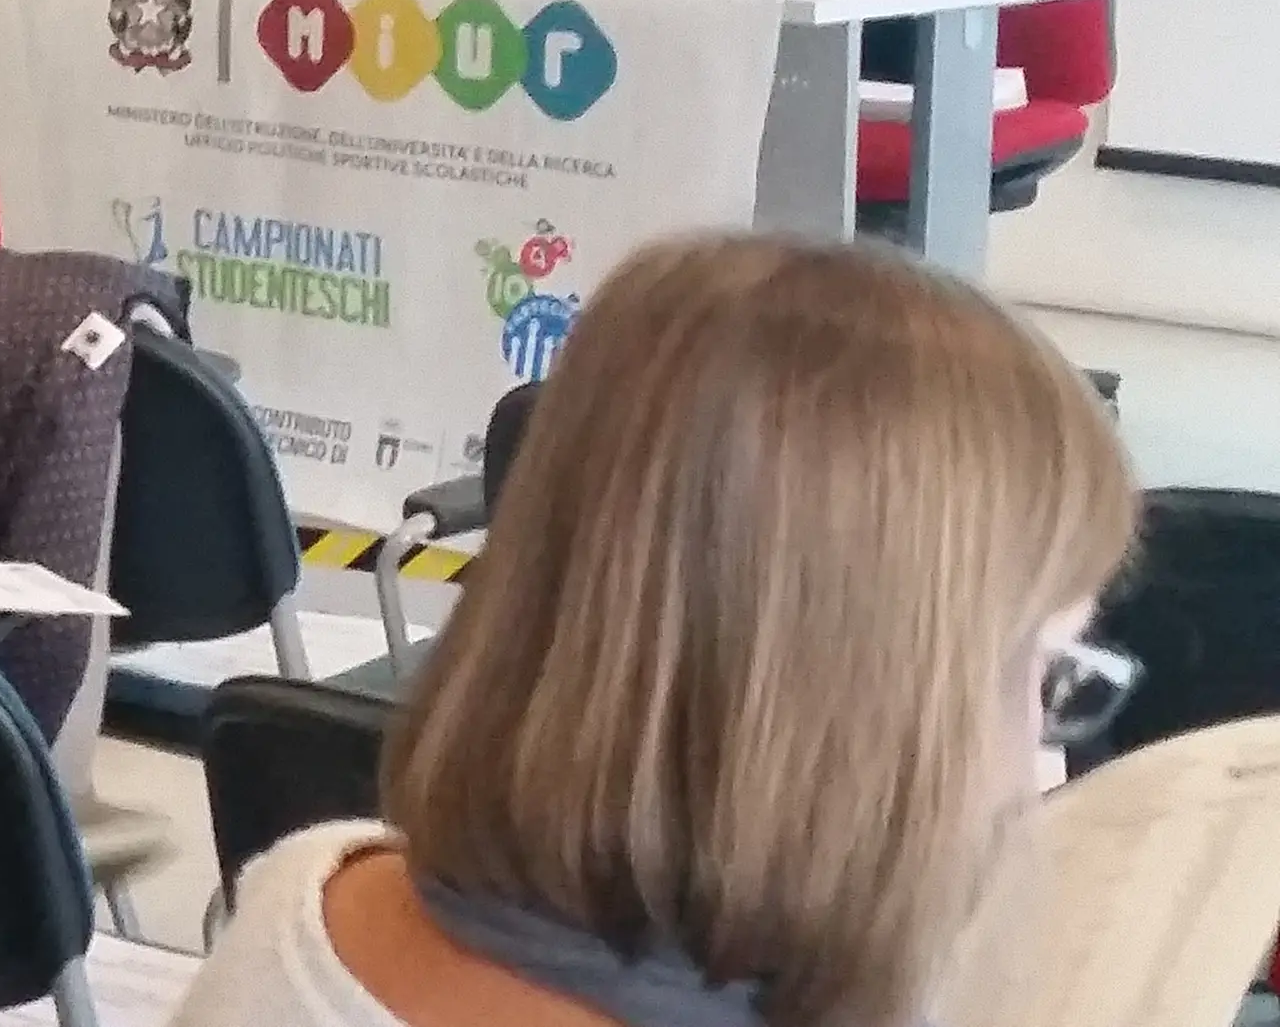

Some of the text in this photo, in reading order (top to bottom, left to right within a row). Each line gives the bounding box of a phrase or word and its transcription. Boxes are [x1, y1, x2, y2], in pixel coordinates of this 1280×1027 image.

[332, 152, 409, 176] SPORTIVE
[487, 148, 539, 170] DELLA
[542, 154, 617, 179] RICERCA
[193, 207, 382, 278] CAMPIONATI
[176, 249, 390, 329] STUDENTESCHI
